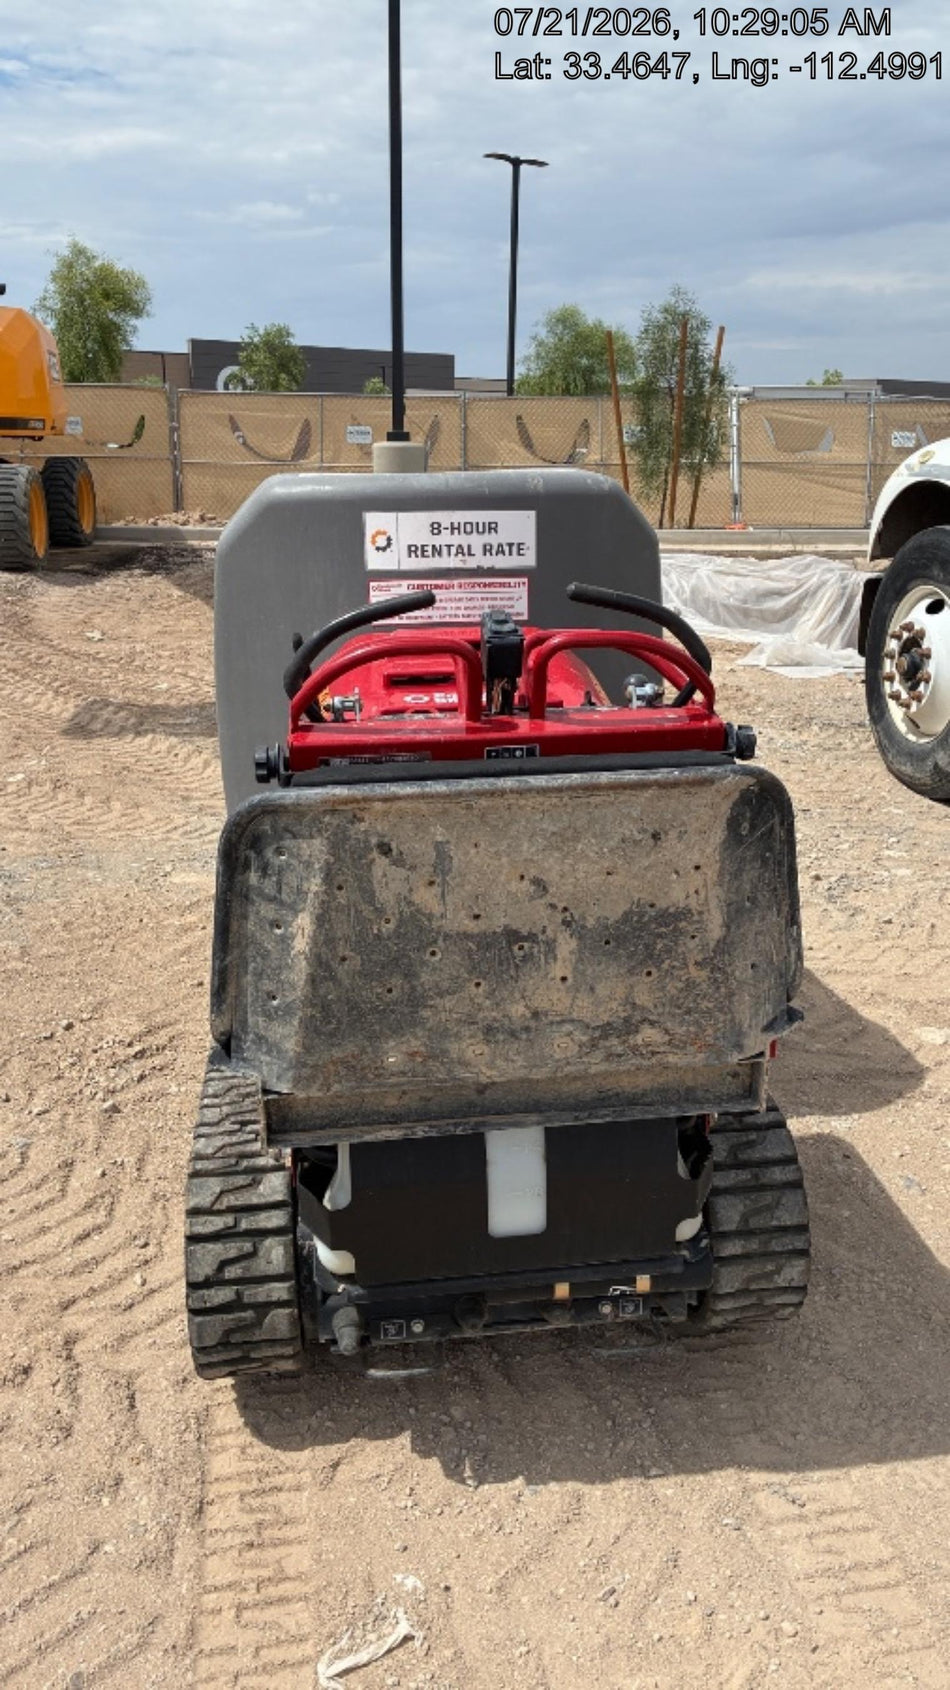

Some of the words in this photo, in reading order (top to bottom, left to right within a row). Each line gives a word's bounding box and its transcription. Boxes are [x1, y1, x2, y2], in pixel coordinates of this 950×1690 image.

[430, 521, 498, 536] 8-HOUR
[407, 543, 475, 558] RENTAL
[482, 542, 525, 557] RATE
